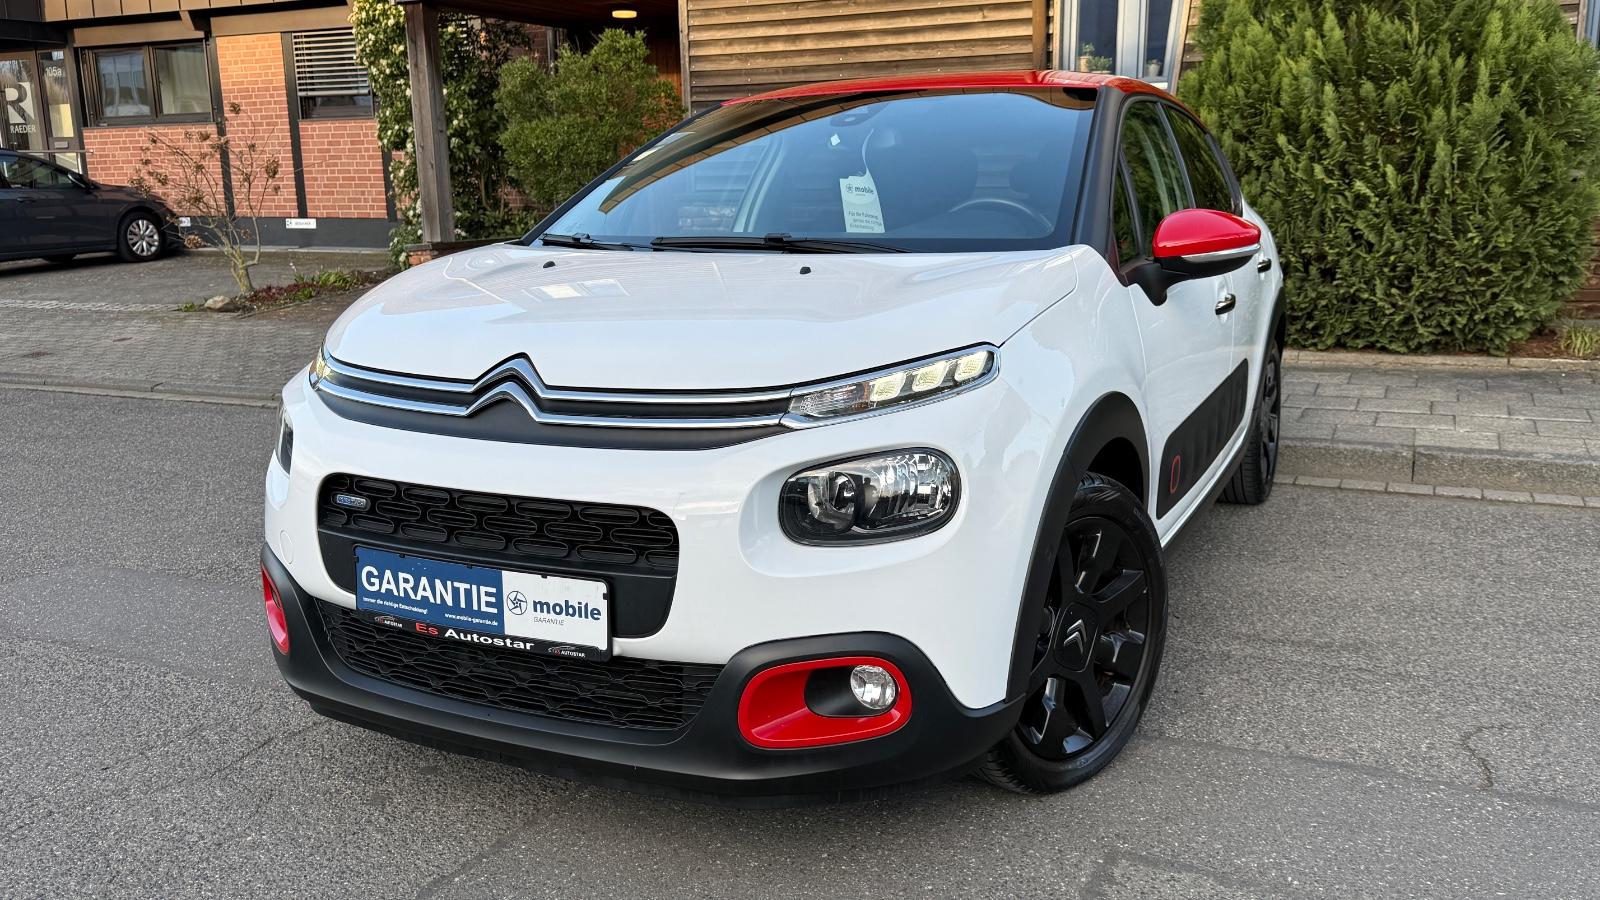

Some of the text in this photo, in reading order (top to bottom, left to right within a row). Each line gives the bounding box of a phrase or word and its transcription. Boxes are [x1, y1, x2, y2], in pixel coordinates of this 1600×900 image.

[45, 66, 63, 77] 105a
[9, 124, 37, 134] RAEDER
[361, 565, 498, 614] GARANTIE
[533, 599, 602, 621] mobile
[534, 616, 565, 626] GARANTIE
[415, 622, 535, 651] Es Autostar
[560, 649, 586, 658] AUTOSTAR
